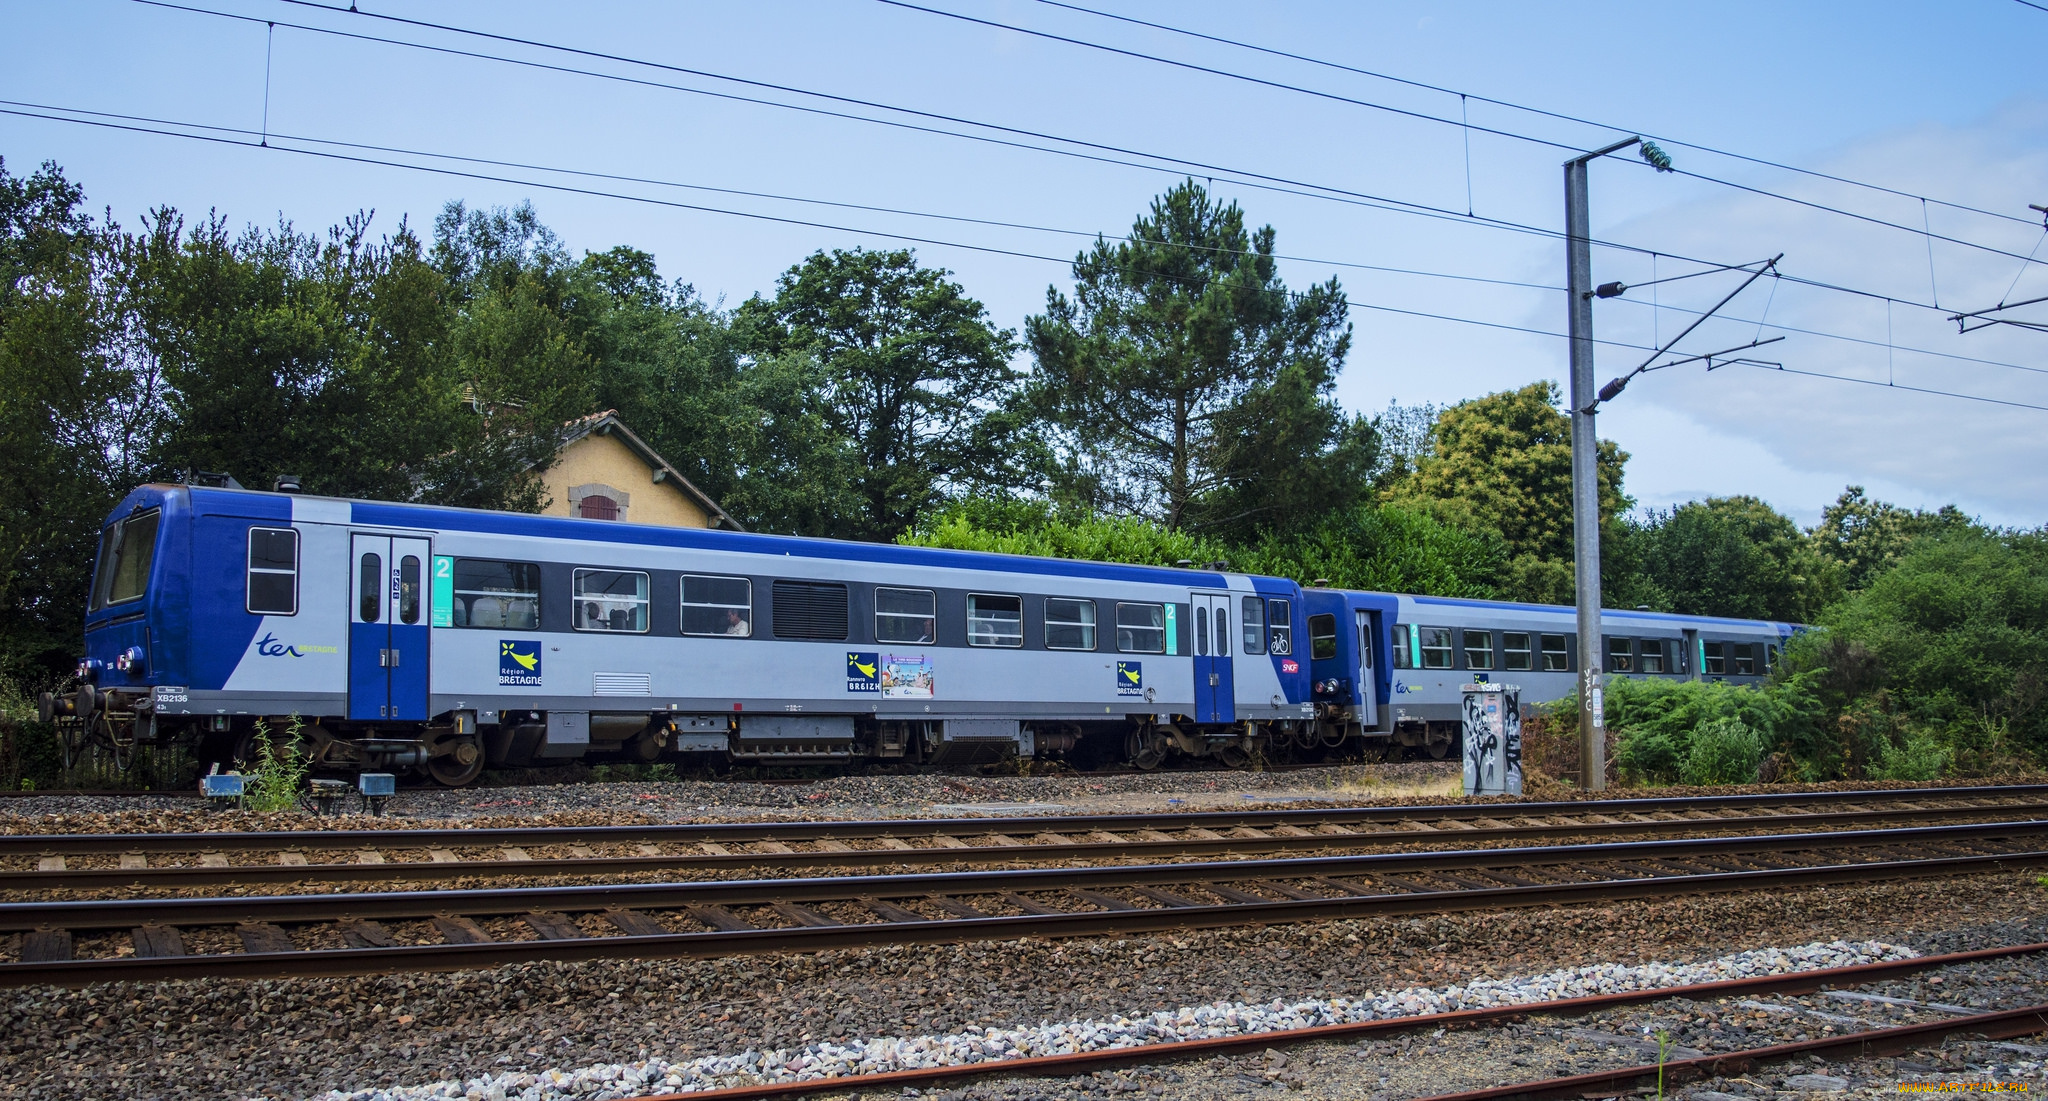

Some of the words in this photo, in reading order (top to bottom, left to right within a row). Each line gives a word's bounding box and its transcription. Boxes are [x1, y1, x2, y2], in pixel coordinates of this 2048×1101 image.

[437, 558, 450, 578] 2
[1168, 606, 1174, 619] 2
[1412, 625, 1418, 637] 2
[256, 632, 304, 658] ter
[499, 676, 542, 684] BRETAGNE
[849, 682, 880, 690] BREIZH
[157, 694, 188, 702] XB2136
